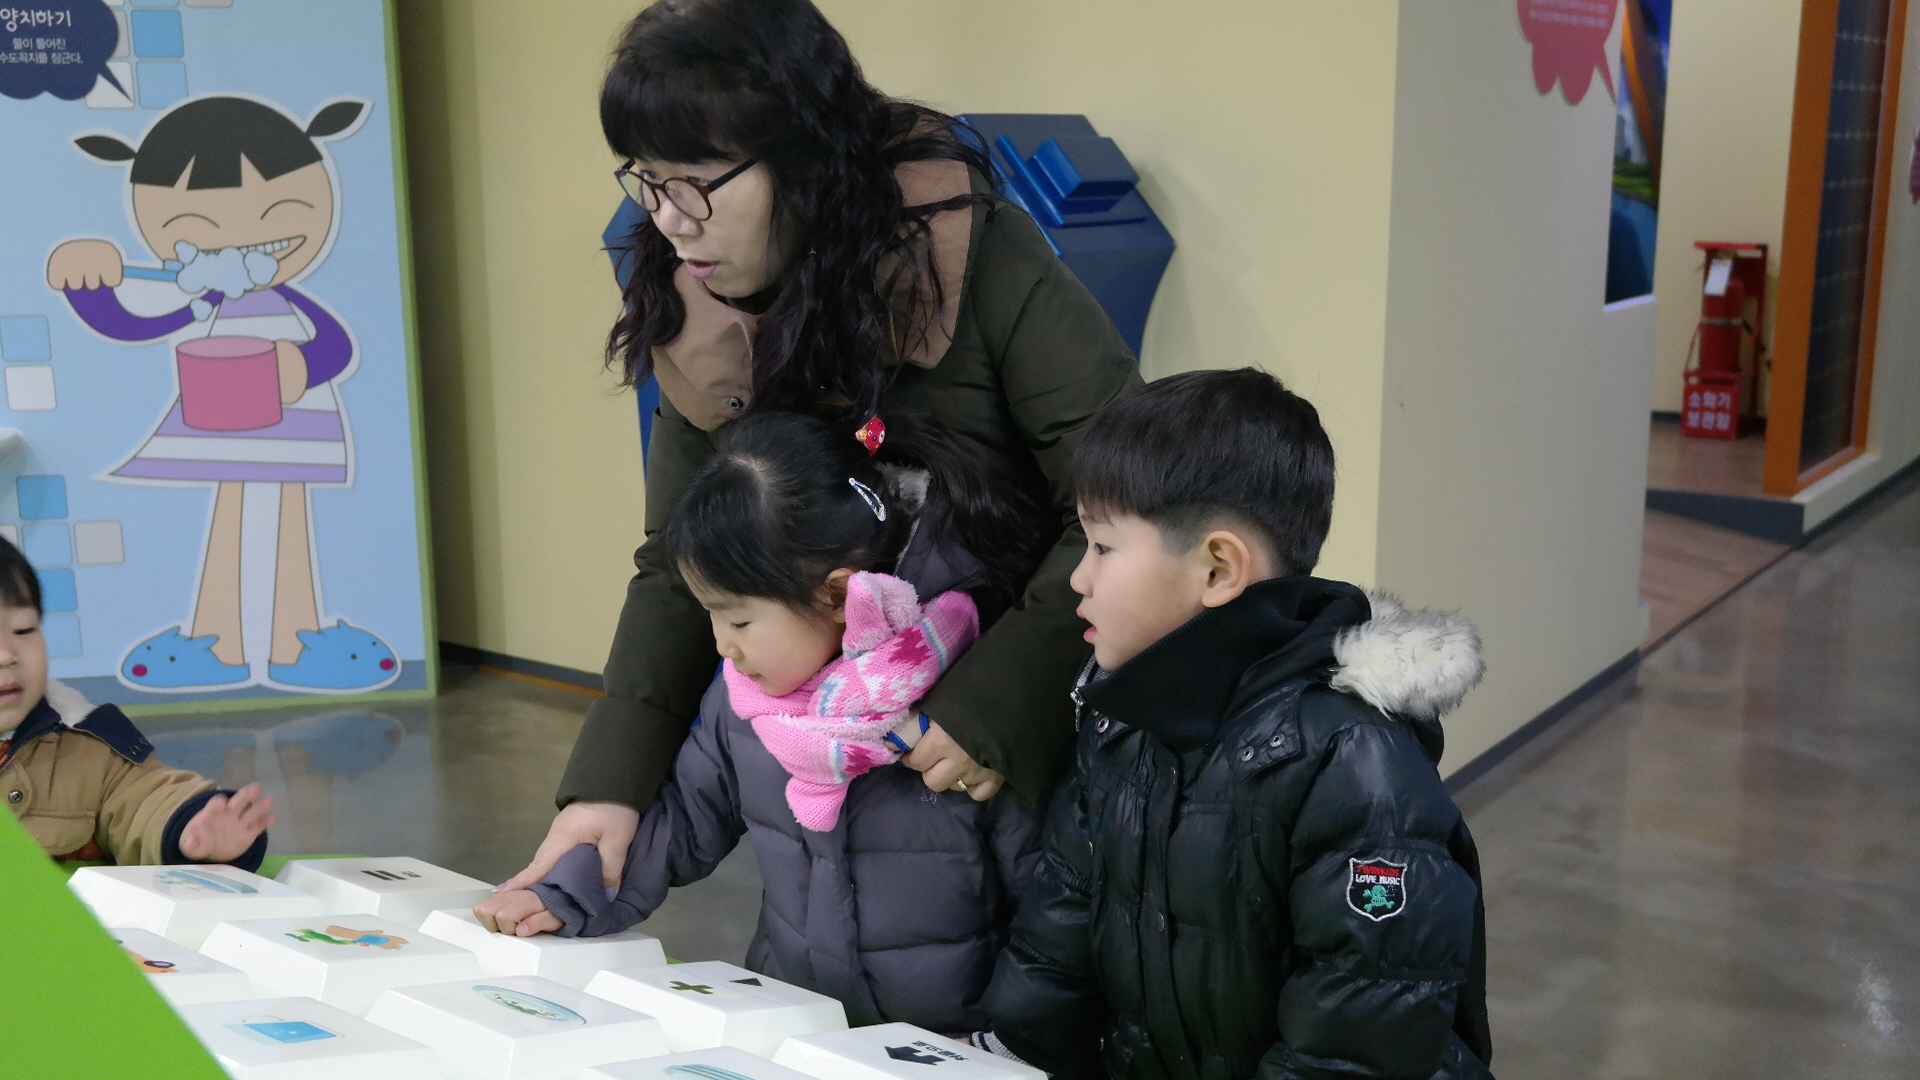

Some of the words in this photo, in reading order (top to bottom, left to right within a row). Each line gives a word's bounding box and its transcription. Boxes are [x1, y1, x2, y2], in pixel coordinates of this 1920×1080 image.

[0, 8, 72, 32] 양치하기
[12, 37, 33, 50] 물이
[0, 51, 48, 64] 수도꼭지를
[1687, 391, 1732, 410] 소화기
[1355, 865, 1400, 877] TWINKIDS
[1355, 874, 1377, 884] LOVE
[1379, 876, 1401, 886] MUSIC
